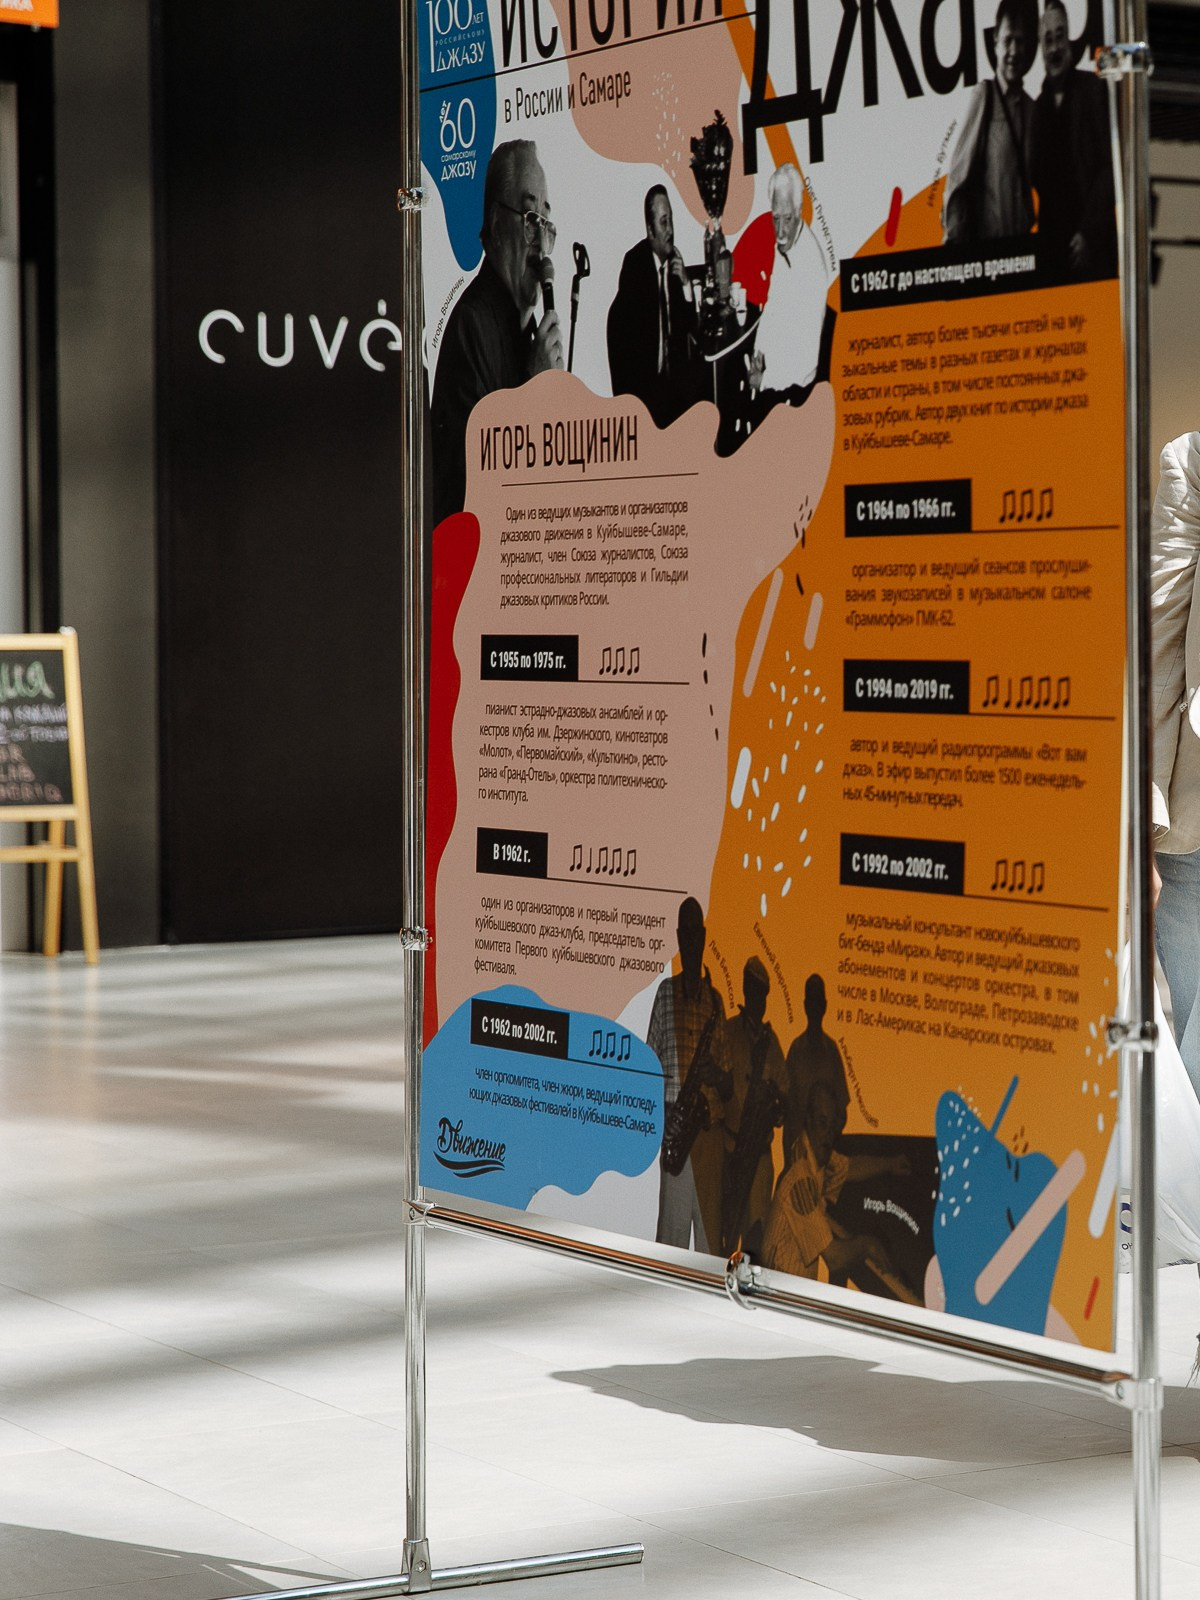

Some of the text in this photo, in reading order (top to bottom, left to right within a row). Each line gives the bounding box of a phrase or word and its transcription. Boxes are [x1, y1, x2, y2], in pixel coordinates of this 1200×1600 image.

[472, 12, 484, 25] ЛЕТ
[436, 41, 486, 72] ДЖАЗУ
[515, 85, 564, 121] России
[568, 85, 575, 110] и
[579, 69, 632, 108] Самаре
[741, 0, 1097, 176] Джа
[440, 97, 476, 152] 60
[851, 255, 1035, 293] С 1962 г до настоящего времени
[431, 276, 465, 349] Игорь Вощинин
[481, 415, 637, 473] ИГОРЬ ВОЩИНИН
[506, 502, 688, 523] Один из ведущих музыкантов и организаторов
[857, 498, 955, 520] С 1964 по 1966 гг.
[500, 522, 688, 545] джазового движения в Куйбышеве-Самаре,
[501, 545, 688, 567] журналист, член Союза журналистов, Союза
[501, 568, 688, 588] профессиональных литераторов и Гильдии
[500, 592, 609, 609] джазовых критиков России.
[491, 651, 566, 668] С 1955 по 1975 гг.
[856, 678, 953, 699] С 1994 по 2019 гг.
[486, 704, 668, 725] пианист эстрадно-джазовых ансамблей и ор-
[480, 724, 668, 747] кестров клуба им. Дзержинского, кинотеатров
[479, 744, 514, 760] «Молот»,
[516, 745, 584, 764] «Первомайский»,
[643, 754, 668, 768] ресто-
[479, 766, 667, 789] рана «Гранд-Отель», оркестра политехническо-
[479, 788, 528, 805] го института.
[494, 844, 530, 862] В 1962 г.
[852, 852, 948, 879] С 1992 по 2002 гг.
[481, 897, 666, 930] один из организаторов и первый президент
[476, 915, 665, 952] куйбышевского джаз-клуба, председатель орг-
[474, 956, 518, 975] фестиваля.
[475, 939, 664, 973] комитета Первого куйбышевского джазового
[482, 1016, 557, 1044] С 1962 по 2002 гг.
[476, 1068, 656, 1115] член оргкомитета, член жюри, ведущий последу-
[470, 1088, 656, 1136] ющих джазовых фестивалей в Куйбышеве-Самаре.
[437, 1117, 506, 1162] Движение
